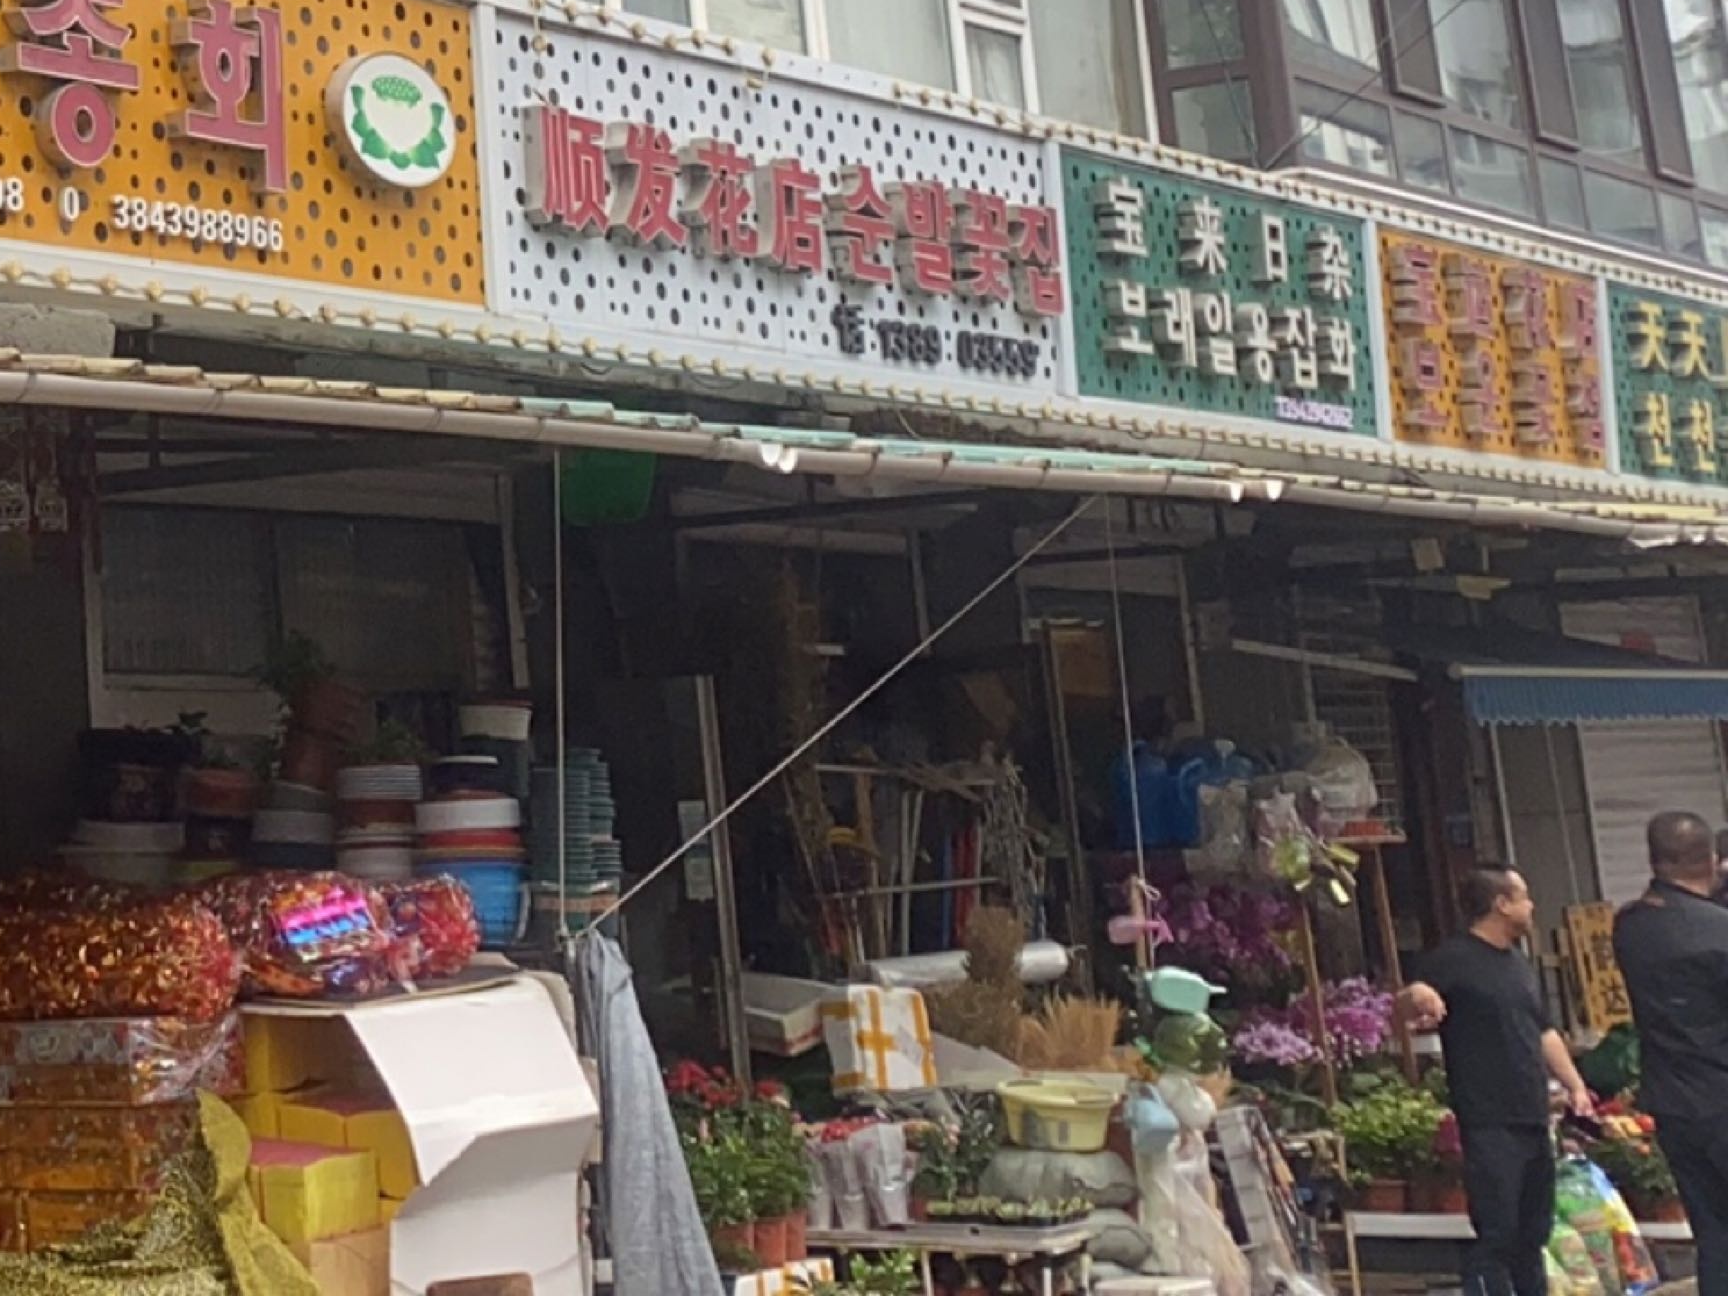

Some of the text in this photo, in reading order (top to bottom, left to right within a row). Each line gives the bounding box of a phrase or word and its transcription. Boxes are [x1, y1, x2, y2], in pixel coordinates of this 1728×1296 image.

[112, 194, 285, 253] 3843988966
[525, 106, 824, 275] 顺发花店
[826, 164, 1065, 317] 순발꽃집
[1095, 175, 1353, 301] 宝来日杂
[1103, 278, 1356, 391] 보래일용잡화
[1633, 391, 1728, 475] 천천
